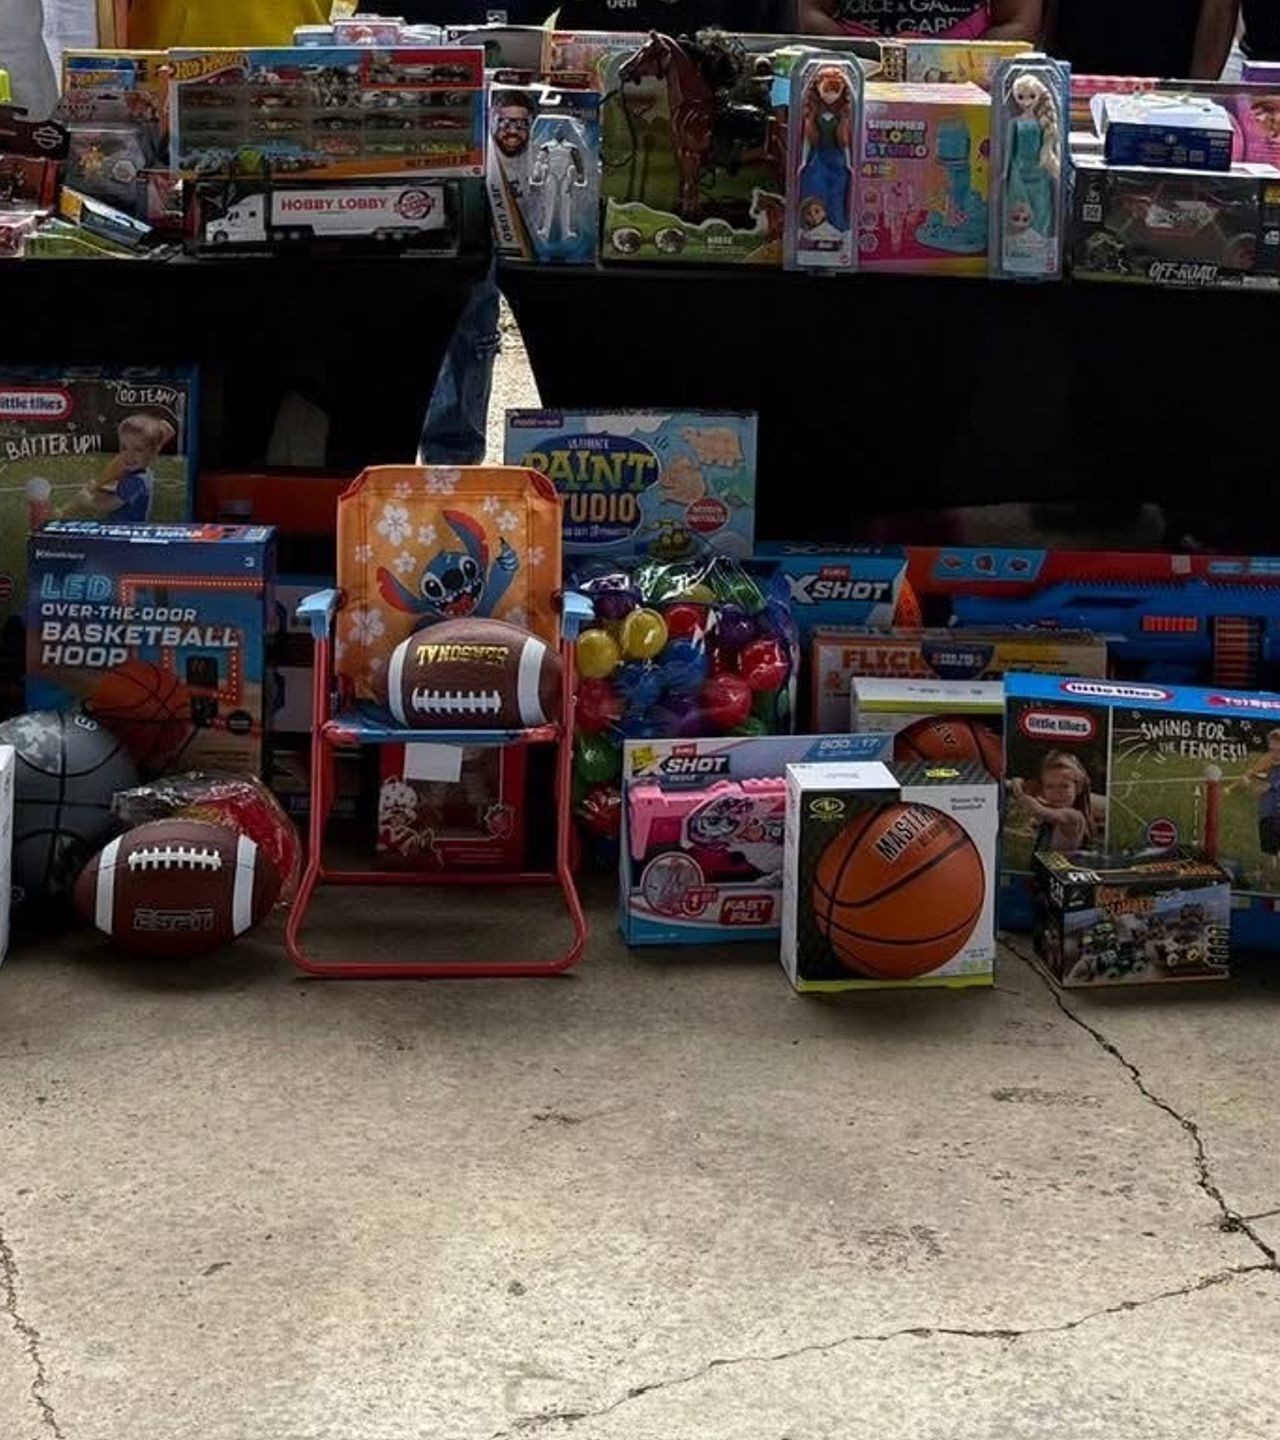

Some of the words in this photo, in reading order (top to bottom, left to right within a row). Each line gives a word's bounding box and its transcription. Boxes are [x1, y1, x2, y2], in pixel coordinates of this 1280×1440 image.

[281, 197, 333, 211] HOBBY
[338, 196, 388, 210] LOBBY
[120, 390, 138, 402] GO
[5, 434, 68, 461] BATTER
[523, 449, 657, 492] PAINT
[40, 573, 113, 600] LED
[40, 603, 197, 622] OVER-THE-DOOR
[40, 621, 240, 647] BASKETBALL
[40, 644, 128, 668] HOOP
[1140, 719, 1193, 741] SWING
[1197, 721, 1226, 741] FOR
[725, 897, 769, 912] FAST
